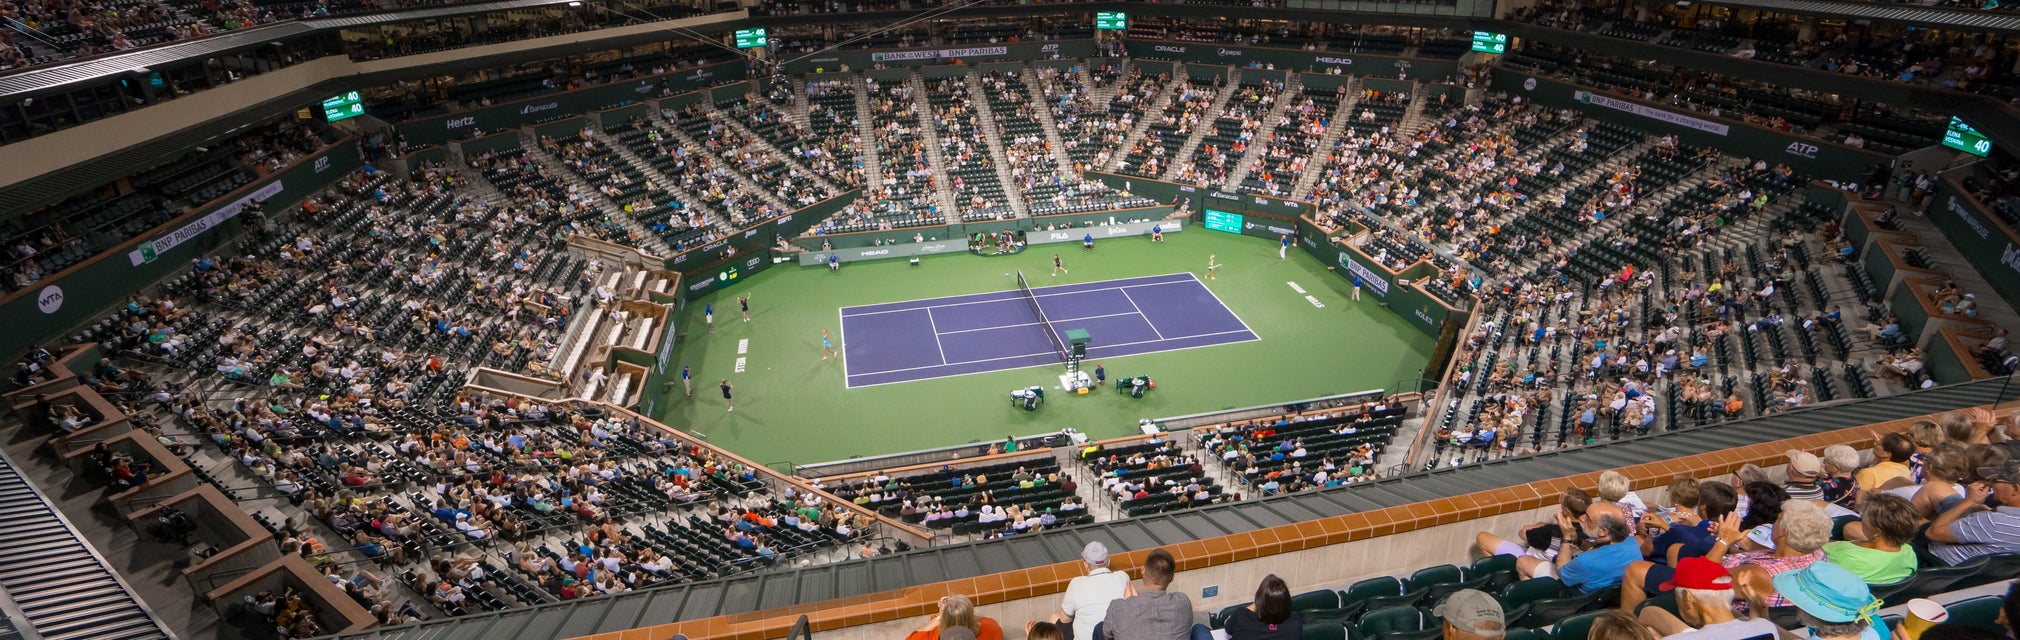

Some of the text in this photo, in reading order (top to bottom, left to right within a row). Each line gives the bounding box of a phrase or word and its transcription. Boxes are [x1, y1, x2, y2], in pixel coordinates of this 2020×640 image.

[1495, 34, 1506, 42] 40
[949, 46, 1005, 57] BNP PARIBAS
[1155, 45, 1187, 53] ORACLE
[1493, 43, 1504, 52] 40
[884, 52, 908, 60] BANK
[1315, 56, 1352, 65] HEAD
[347, 91, 359, 101] 40
[351, 103, 362, 113] 40
[1592, 95, 1605, 106] BNP
[1606, 98, 1634, 112] PARIBAS
[446, 116, 476, 129] Hertz
[1787, 141, 1819, 154] ATP
[1974, 139, 1990, 153] 40
[314, 155, 329, 169] ATP
[155, 236, 172, 253] BNP
[174, 219, 207, 243] PARIBAS
[703, 240, 728, 252] ORACLE
[1350, 260, 1362, 275] BNP
[1362, 268, 1387, 292] PARIBAS
[39, 292, 63, 307] WTA
[1415, 309, 1433, 326] ROLEX
